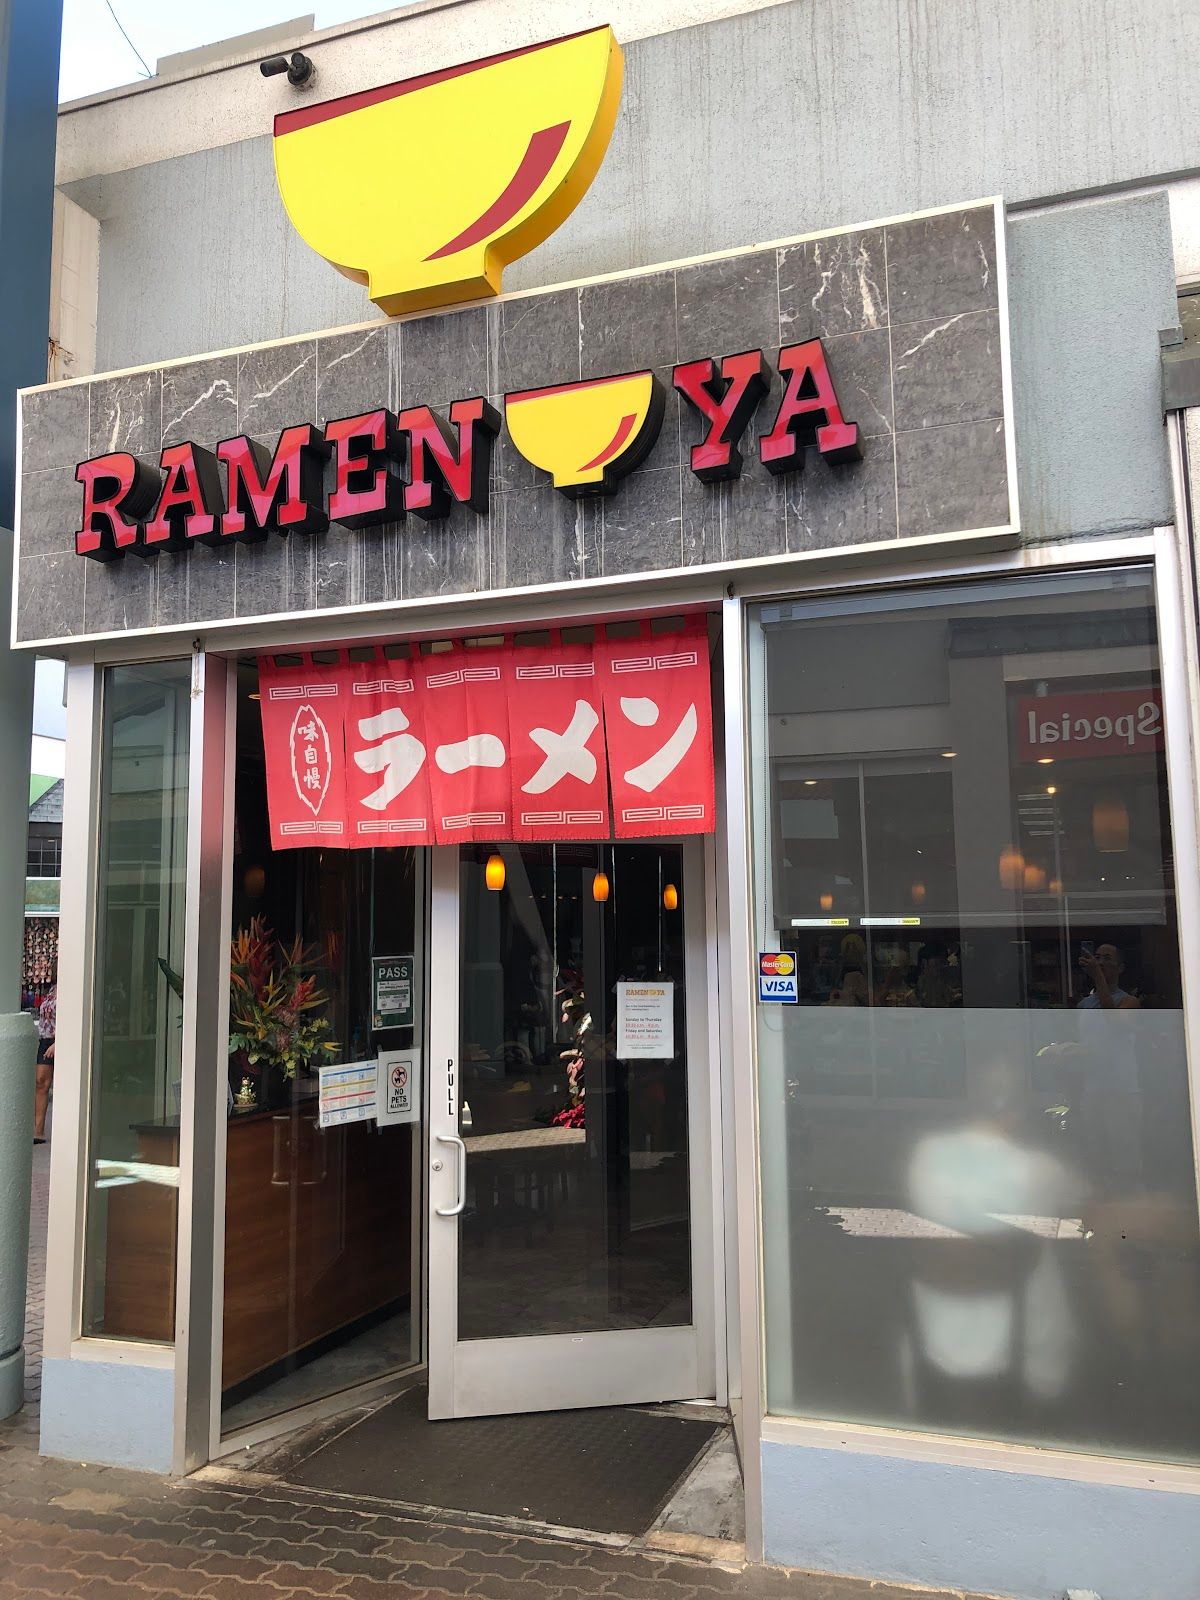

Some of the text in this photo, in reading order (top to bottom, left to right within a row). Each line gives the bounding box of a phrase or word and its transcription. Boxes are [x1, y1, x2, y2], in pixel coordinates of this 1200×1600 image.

[75, 336, 861, 558] RAMEN YA
[297, 719, 321, 790] 味自慢
[354, 697, 698, 811] ラーメン
[378, 966, 408, 979] PASS
[765, 981, 794, 992] VISA
[394, 1088, 404, 1096] NO
[391, 1095, 407, 1104] PETS
